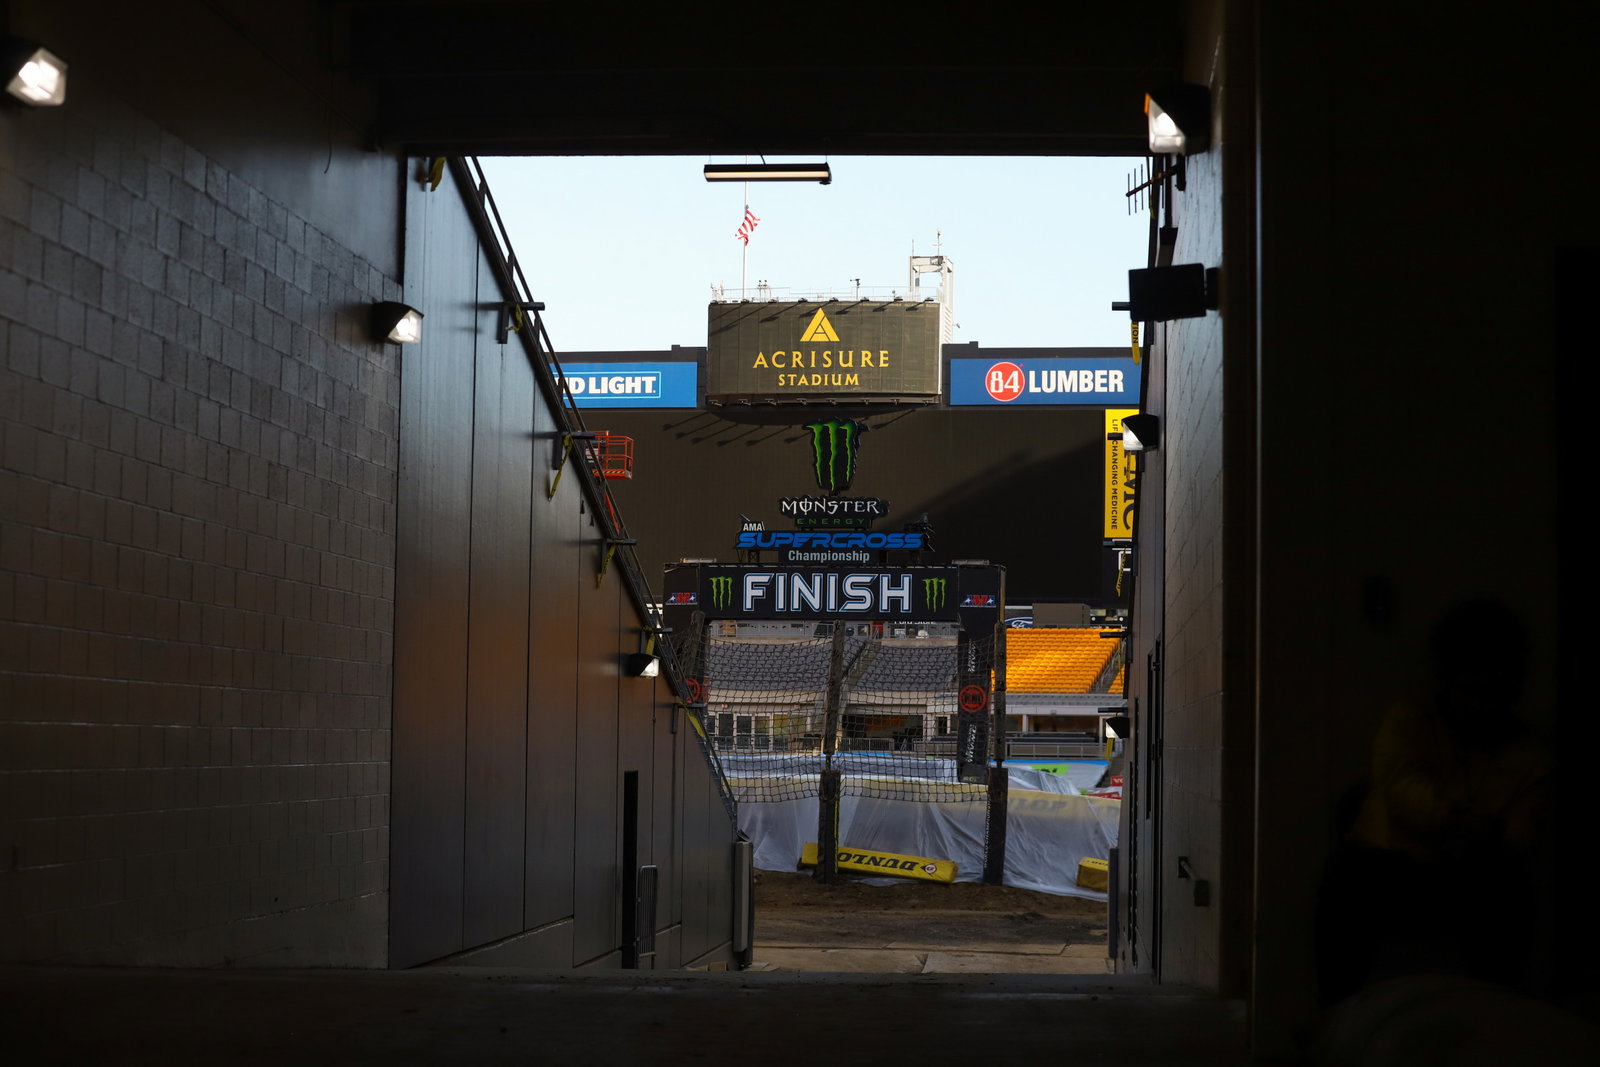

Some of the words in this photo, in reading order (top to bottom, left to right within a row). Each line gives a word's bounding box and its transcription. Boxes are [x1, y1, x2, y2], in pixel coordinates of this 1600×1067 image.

[753, 350, 889, 369] ACRISURE
[778, 373, 860, 387] STADIUM
[990, 370, 1020, 393] 84
[1028, 369, 1124, 393] LUMBER
[1111, 440, 1119, 486] CHANGING
[782, 497, 880, 515] MONSTER
[1111, 488, 1119, 530] MEDICINE
[742, 523, 763, 531] AMA
[736, 532, 925, 549] SUPERCROSS
[788, 550, 870, 563] Championship
[743, 572, 913, 613] FINISH
[837, 851, 919, 871] DUNLO
